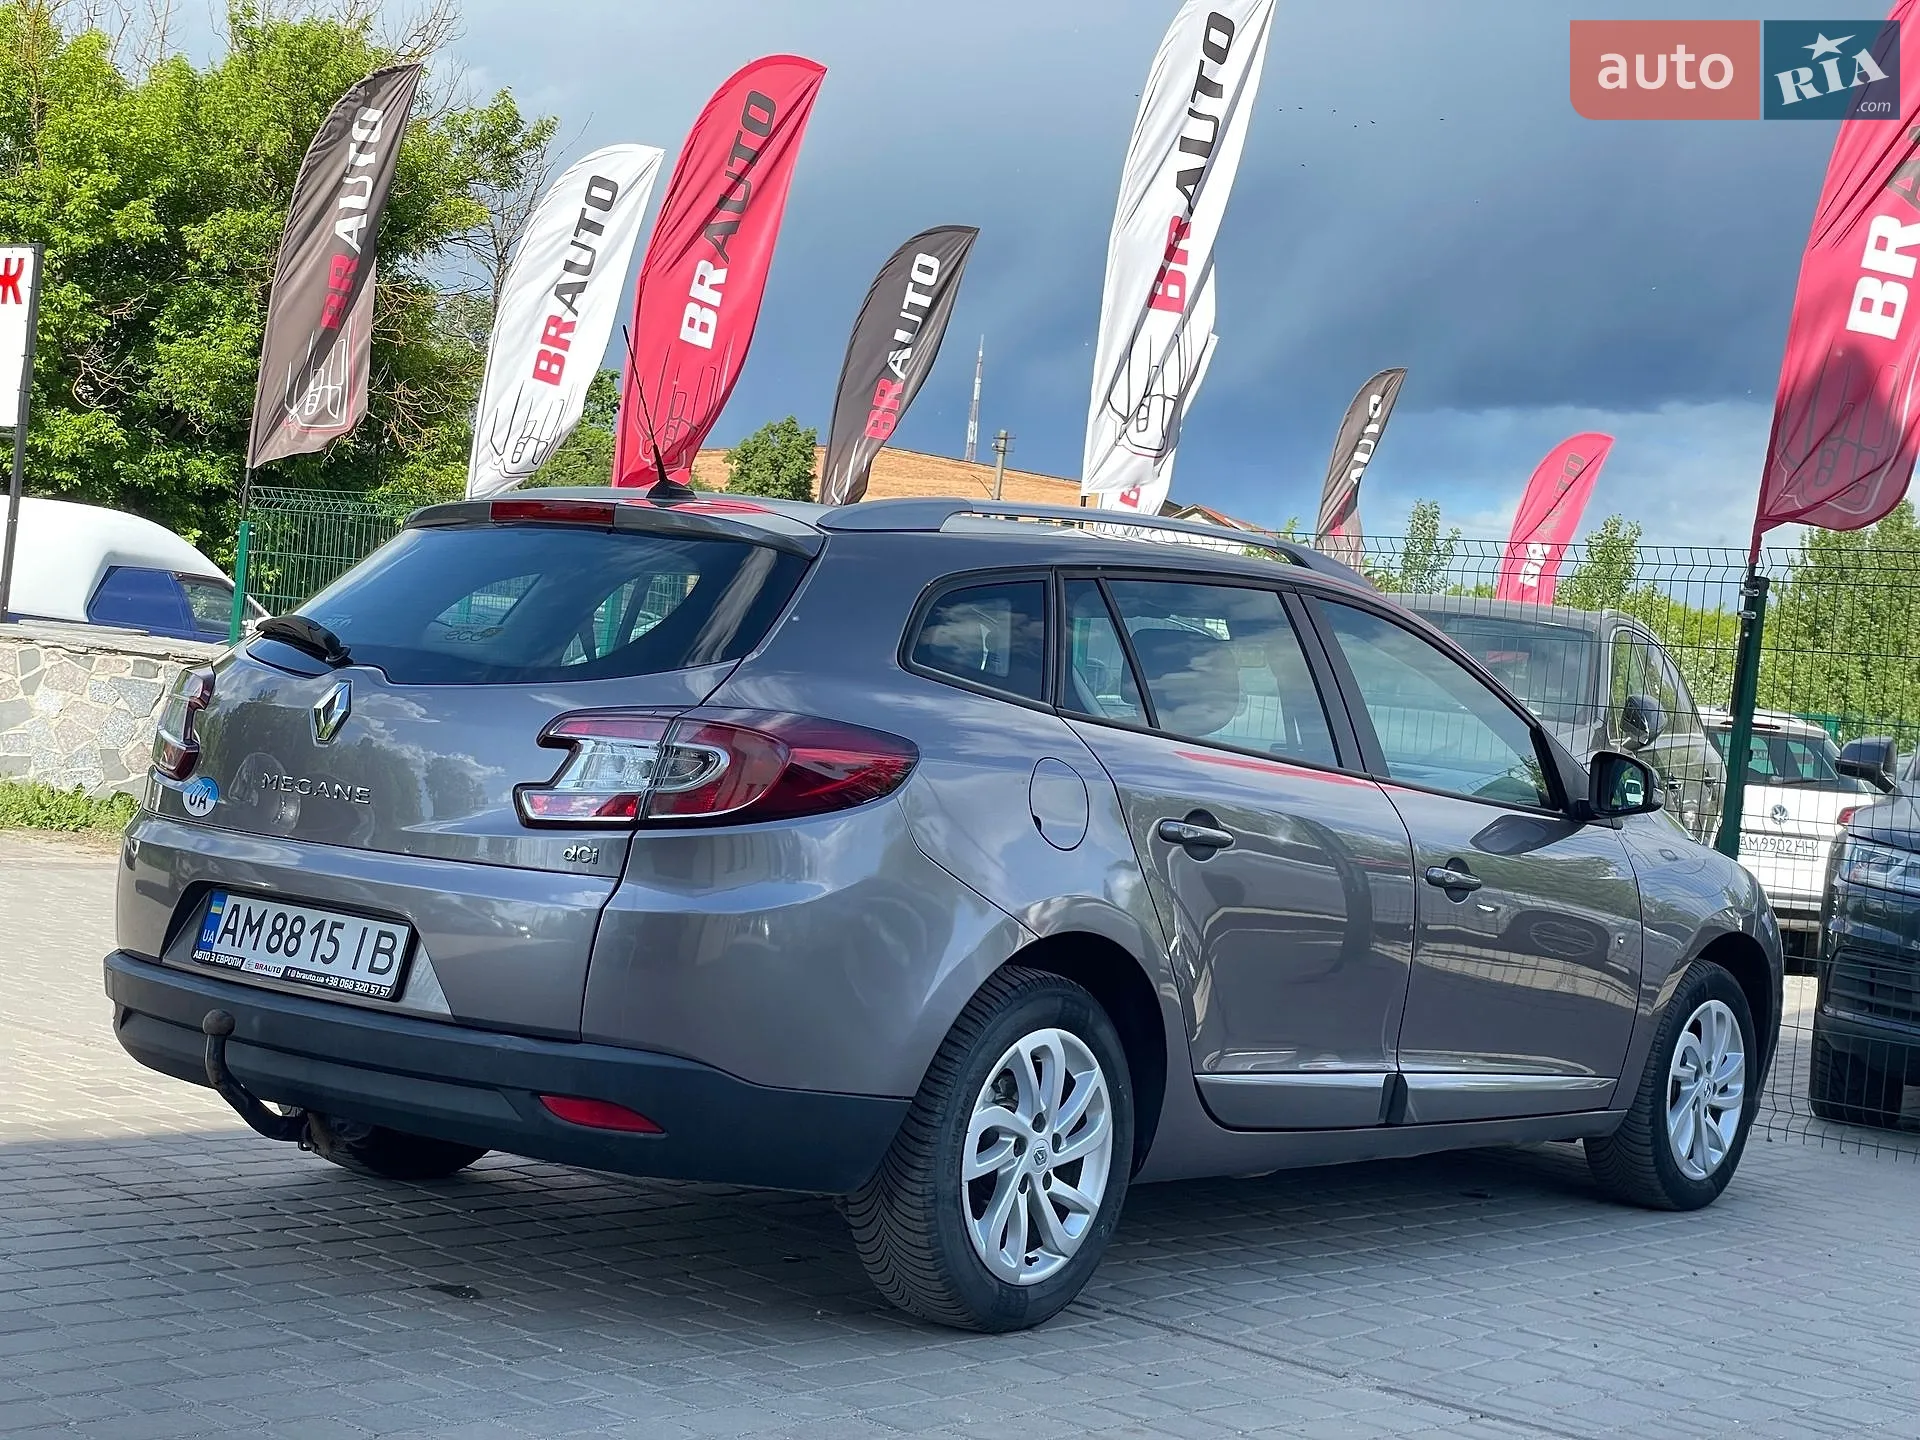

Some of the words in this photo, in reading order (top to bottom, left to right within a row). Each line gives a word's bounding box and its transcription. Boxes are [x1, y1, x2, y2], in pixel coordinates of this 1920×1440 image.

[320, 107, 384, 329] BRAUTO
[679, 90, 776, 349] BRAUTO
[532, 175, 619, 386] BRAUTO
[865, 252, 941, 440] BRAUTO
[189, 784, 211, 810] UA
[261, 772, 371, 804] MEGANE
[563, 845, 599, 864] dCi
[202, 929, 215, 943] UA
[254, 962, 282, 974] BRAUTO
